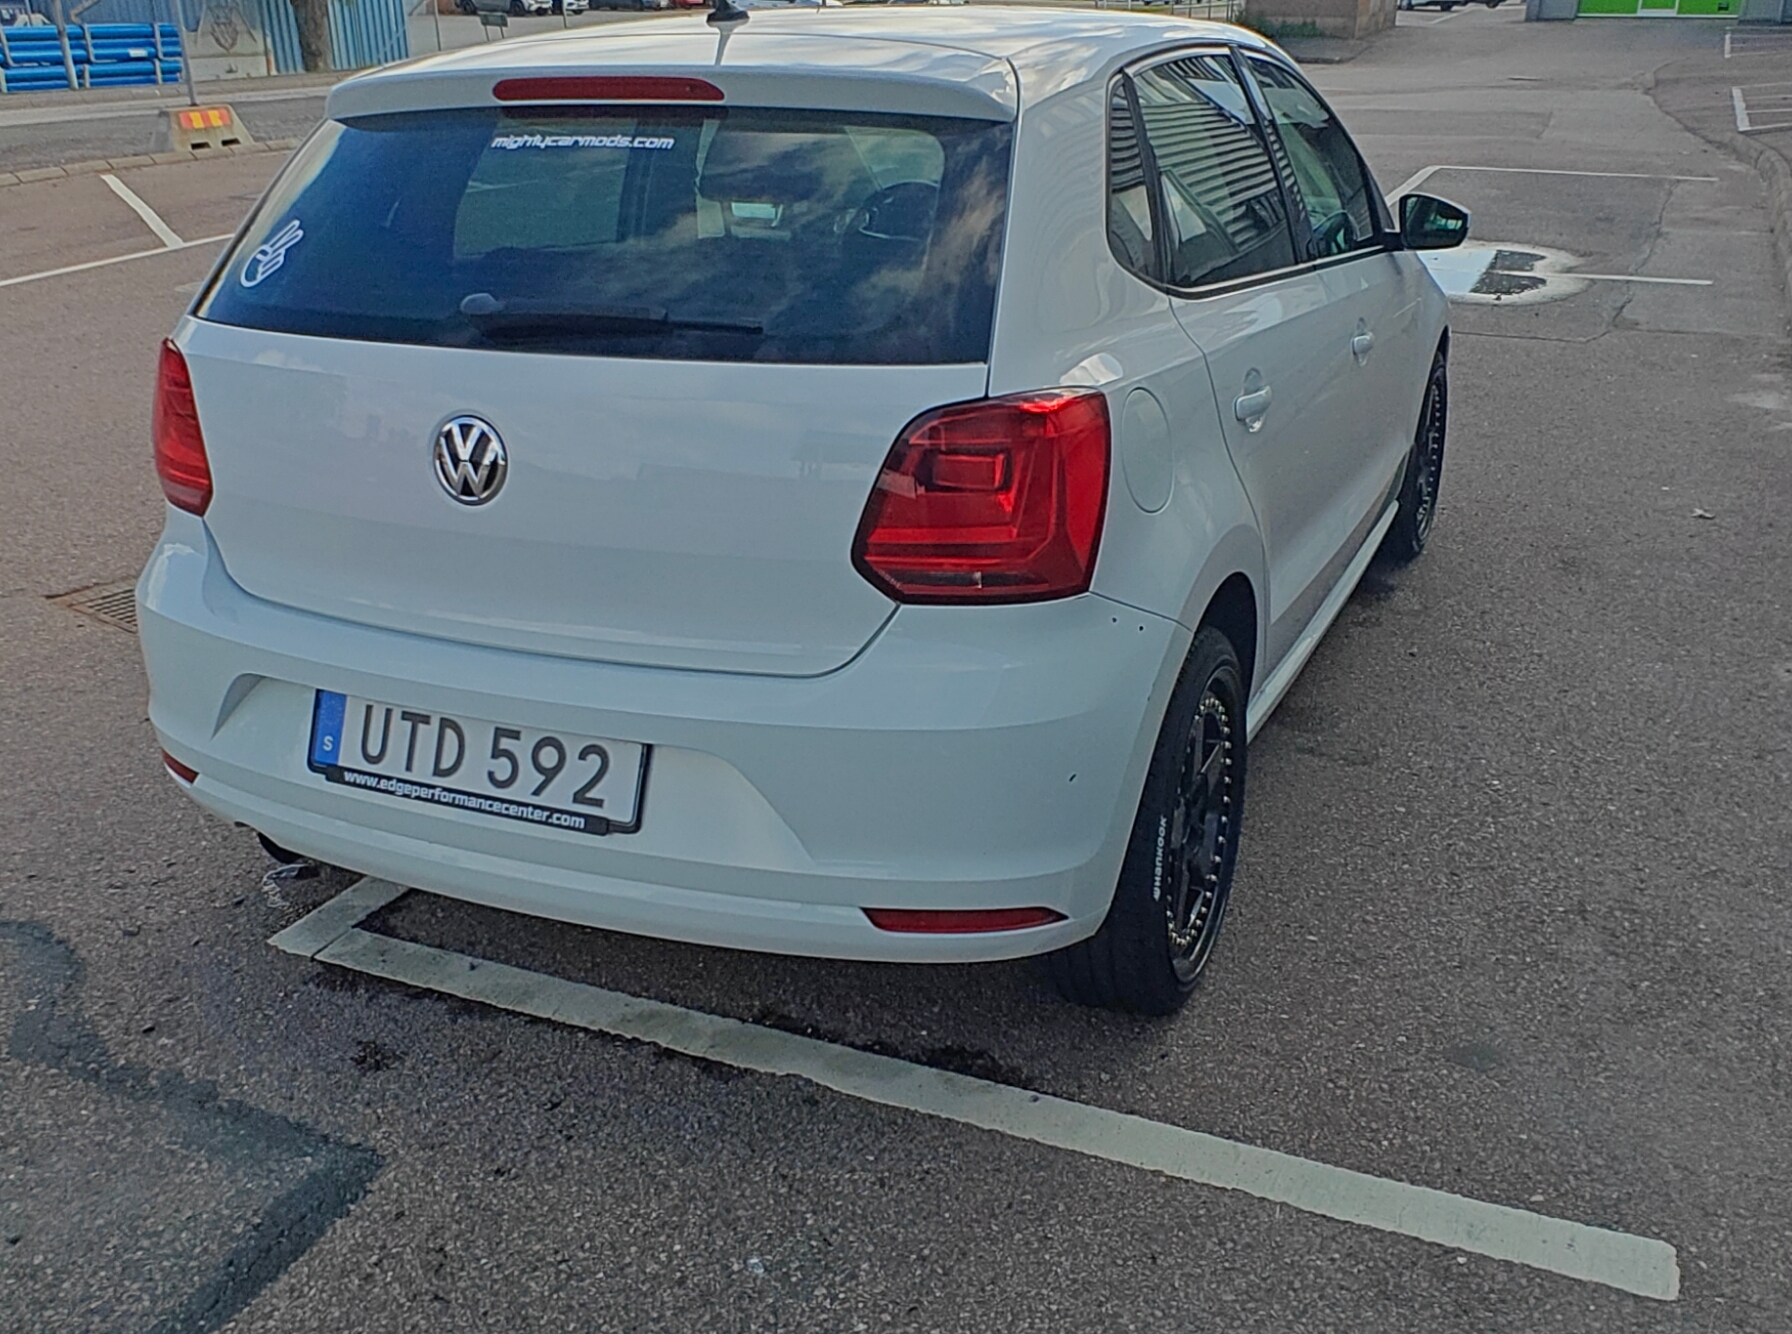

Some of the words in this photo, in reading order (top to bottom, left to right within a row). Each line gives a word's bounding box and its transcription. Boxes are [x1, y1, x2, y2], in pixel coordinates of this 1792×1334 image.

[491, 134, 675, 150] mightycarmods.com
[323, 735, 334, 752] S
[361, 704, 466, 778] UTD
[487, 726, 610, 808] 592
[343, 770, 585, 829] www.edgeperformancecenter.com
